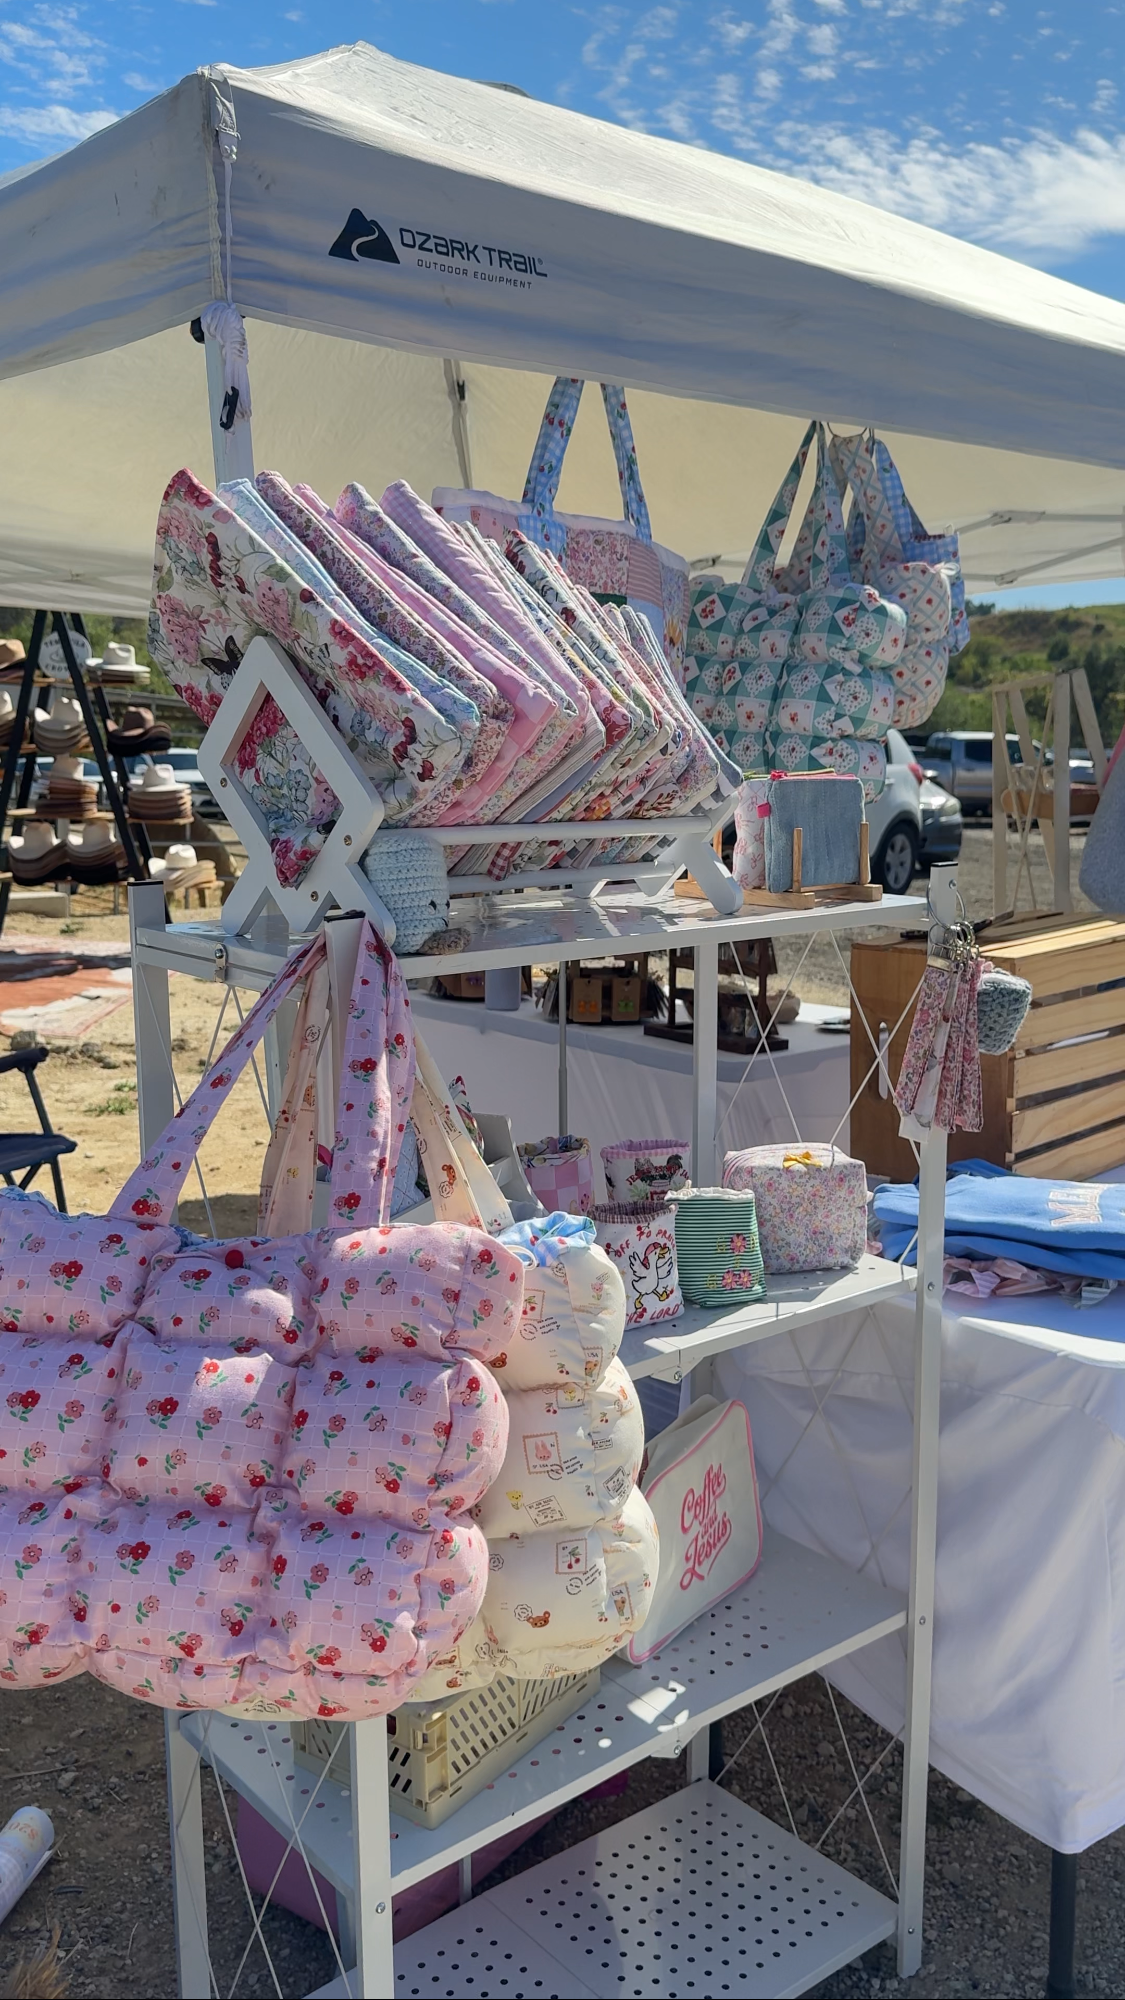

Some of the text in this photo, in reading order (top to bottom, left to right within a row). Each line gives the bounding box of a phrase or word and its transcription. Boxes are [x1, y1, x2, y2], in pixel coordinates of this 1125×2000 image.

[417, 258, 532, 290] OUTDOOR EQUIPMENT
[626, 1303, 680, 1326] HE LORD
[681, 1463, 726, 1534] Coffee
[680, 1511, 732, 1591] Jesus
